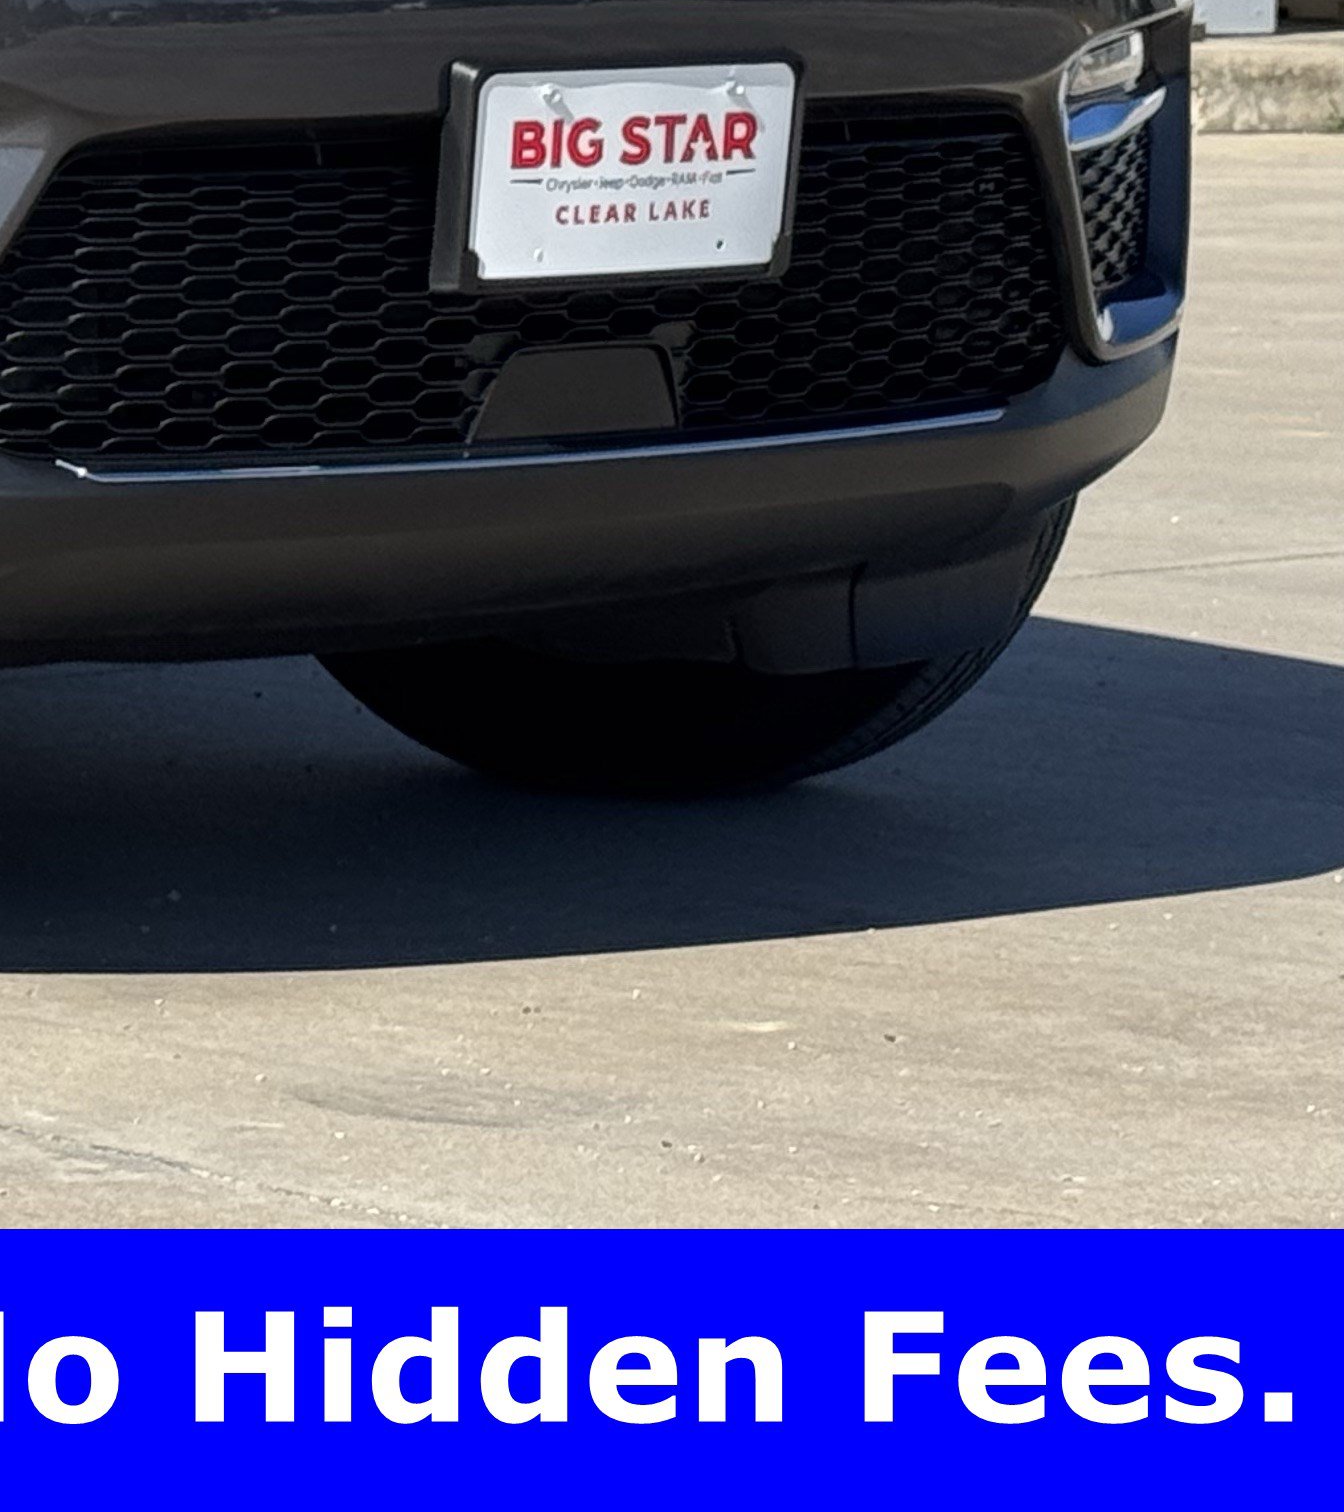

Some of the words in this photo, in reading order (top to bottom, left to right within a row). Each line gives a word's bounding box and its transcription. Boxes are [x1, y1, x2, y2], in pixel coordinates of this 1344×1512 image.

[510, 117, 604, 170] BIG
[619, 110, 758, 165] STAR
[554, 202, 638, 227] CLEAR
[648, 199, 711, 221] LAKE
